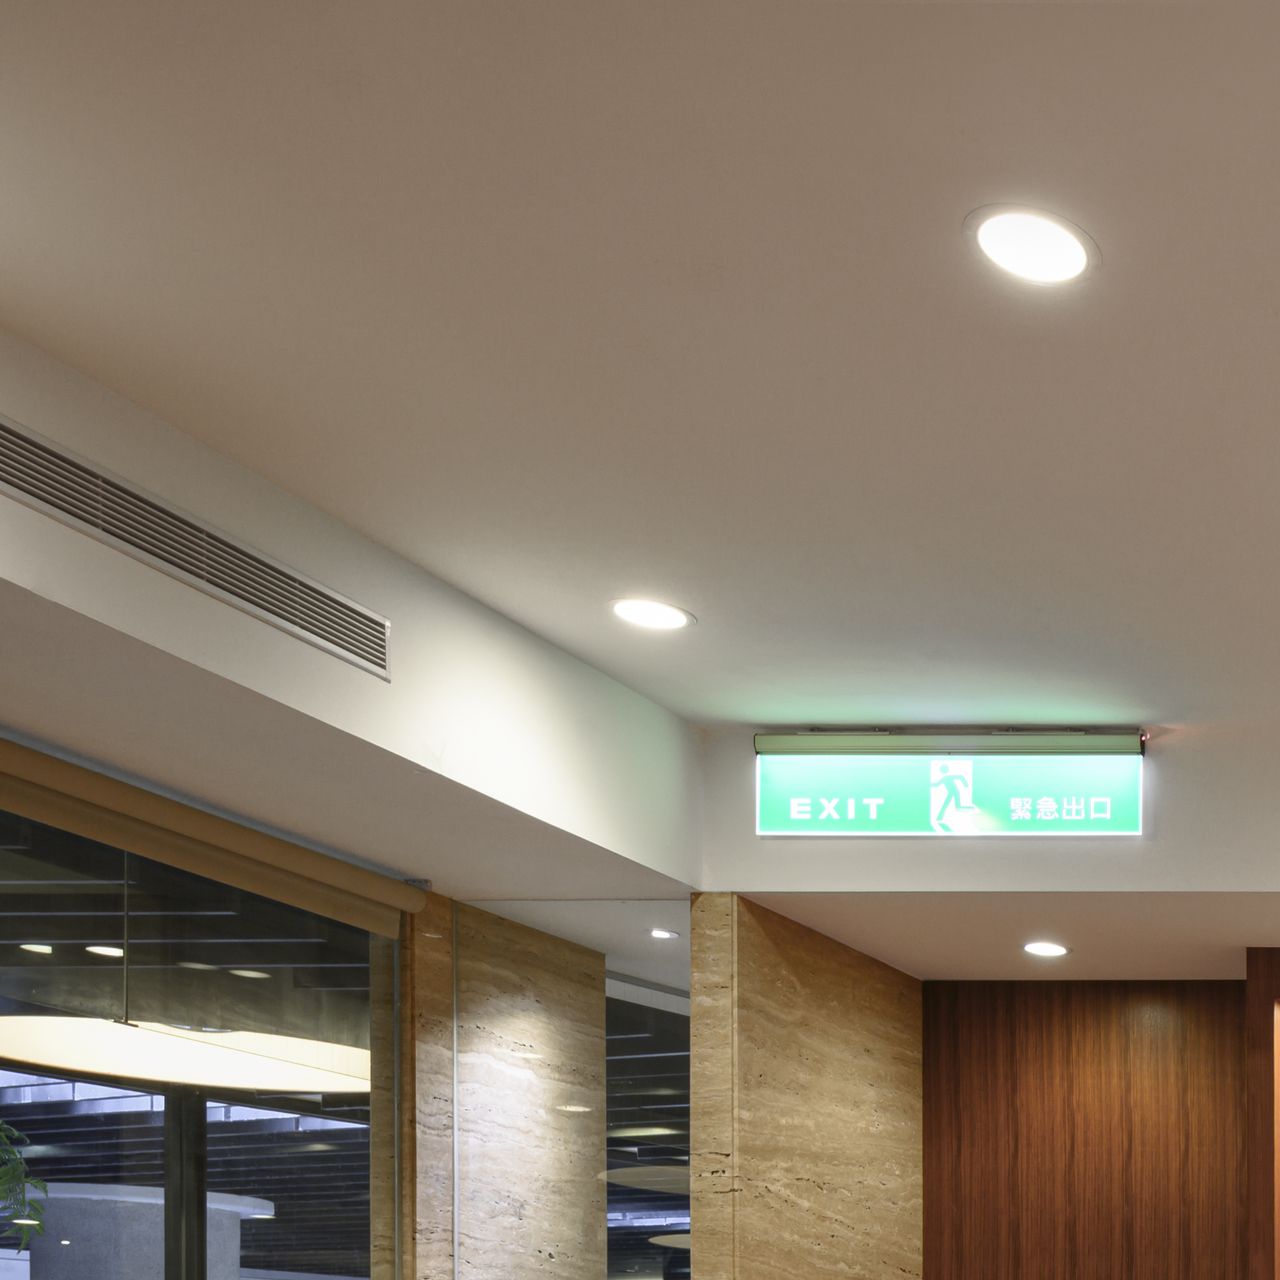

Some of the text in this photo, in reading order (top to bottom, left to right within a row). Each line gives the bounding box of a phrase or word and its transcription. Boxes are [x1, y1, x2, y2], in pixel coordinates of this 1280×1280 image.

[789, 797, 885, 820] EXIT
[1008, 796, 1113, 821] 緊急出口
